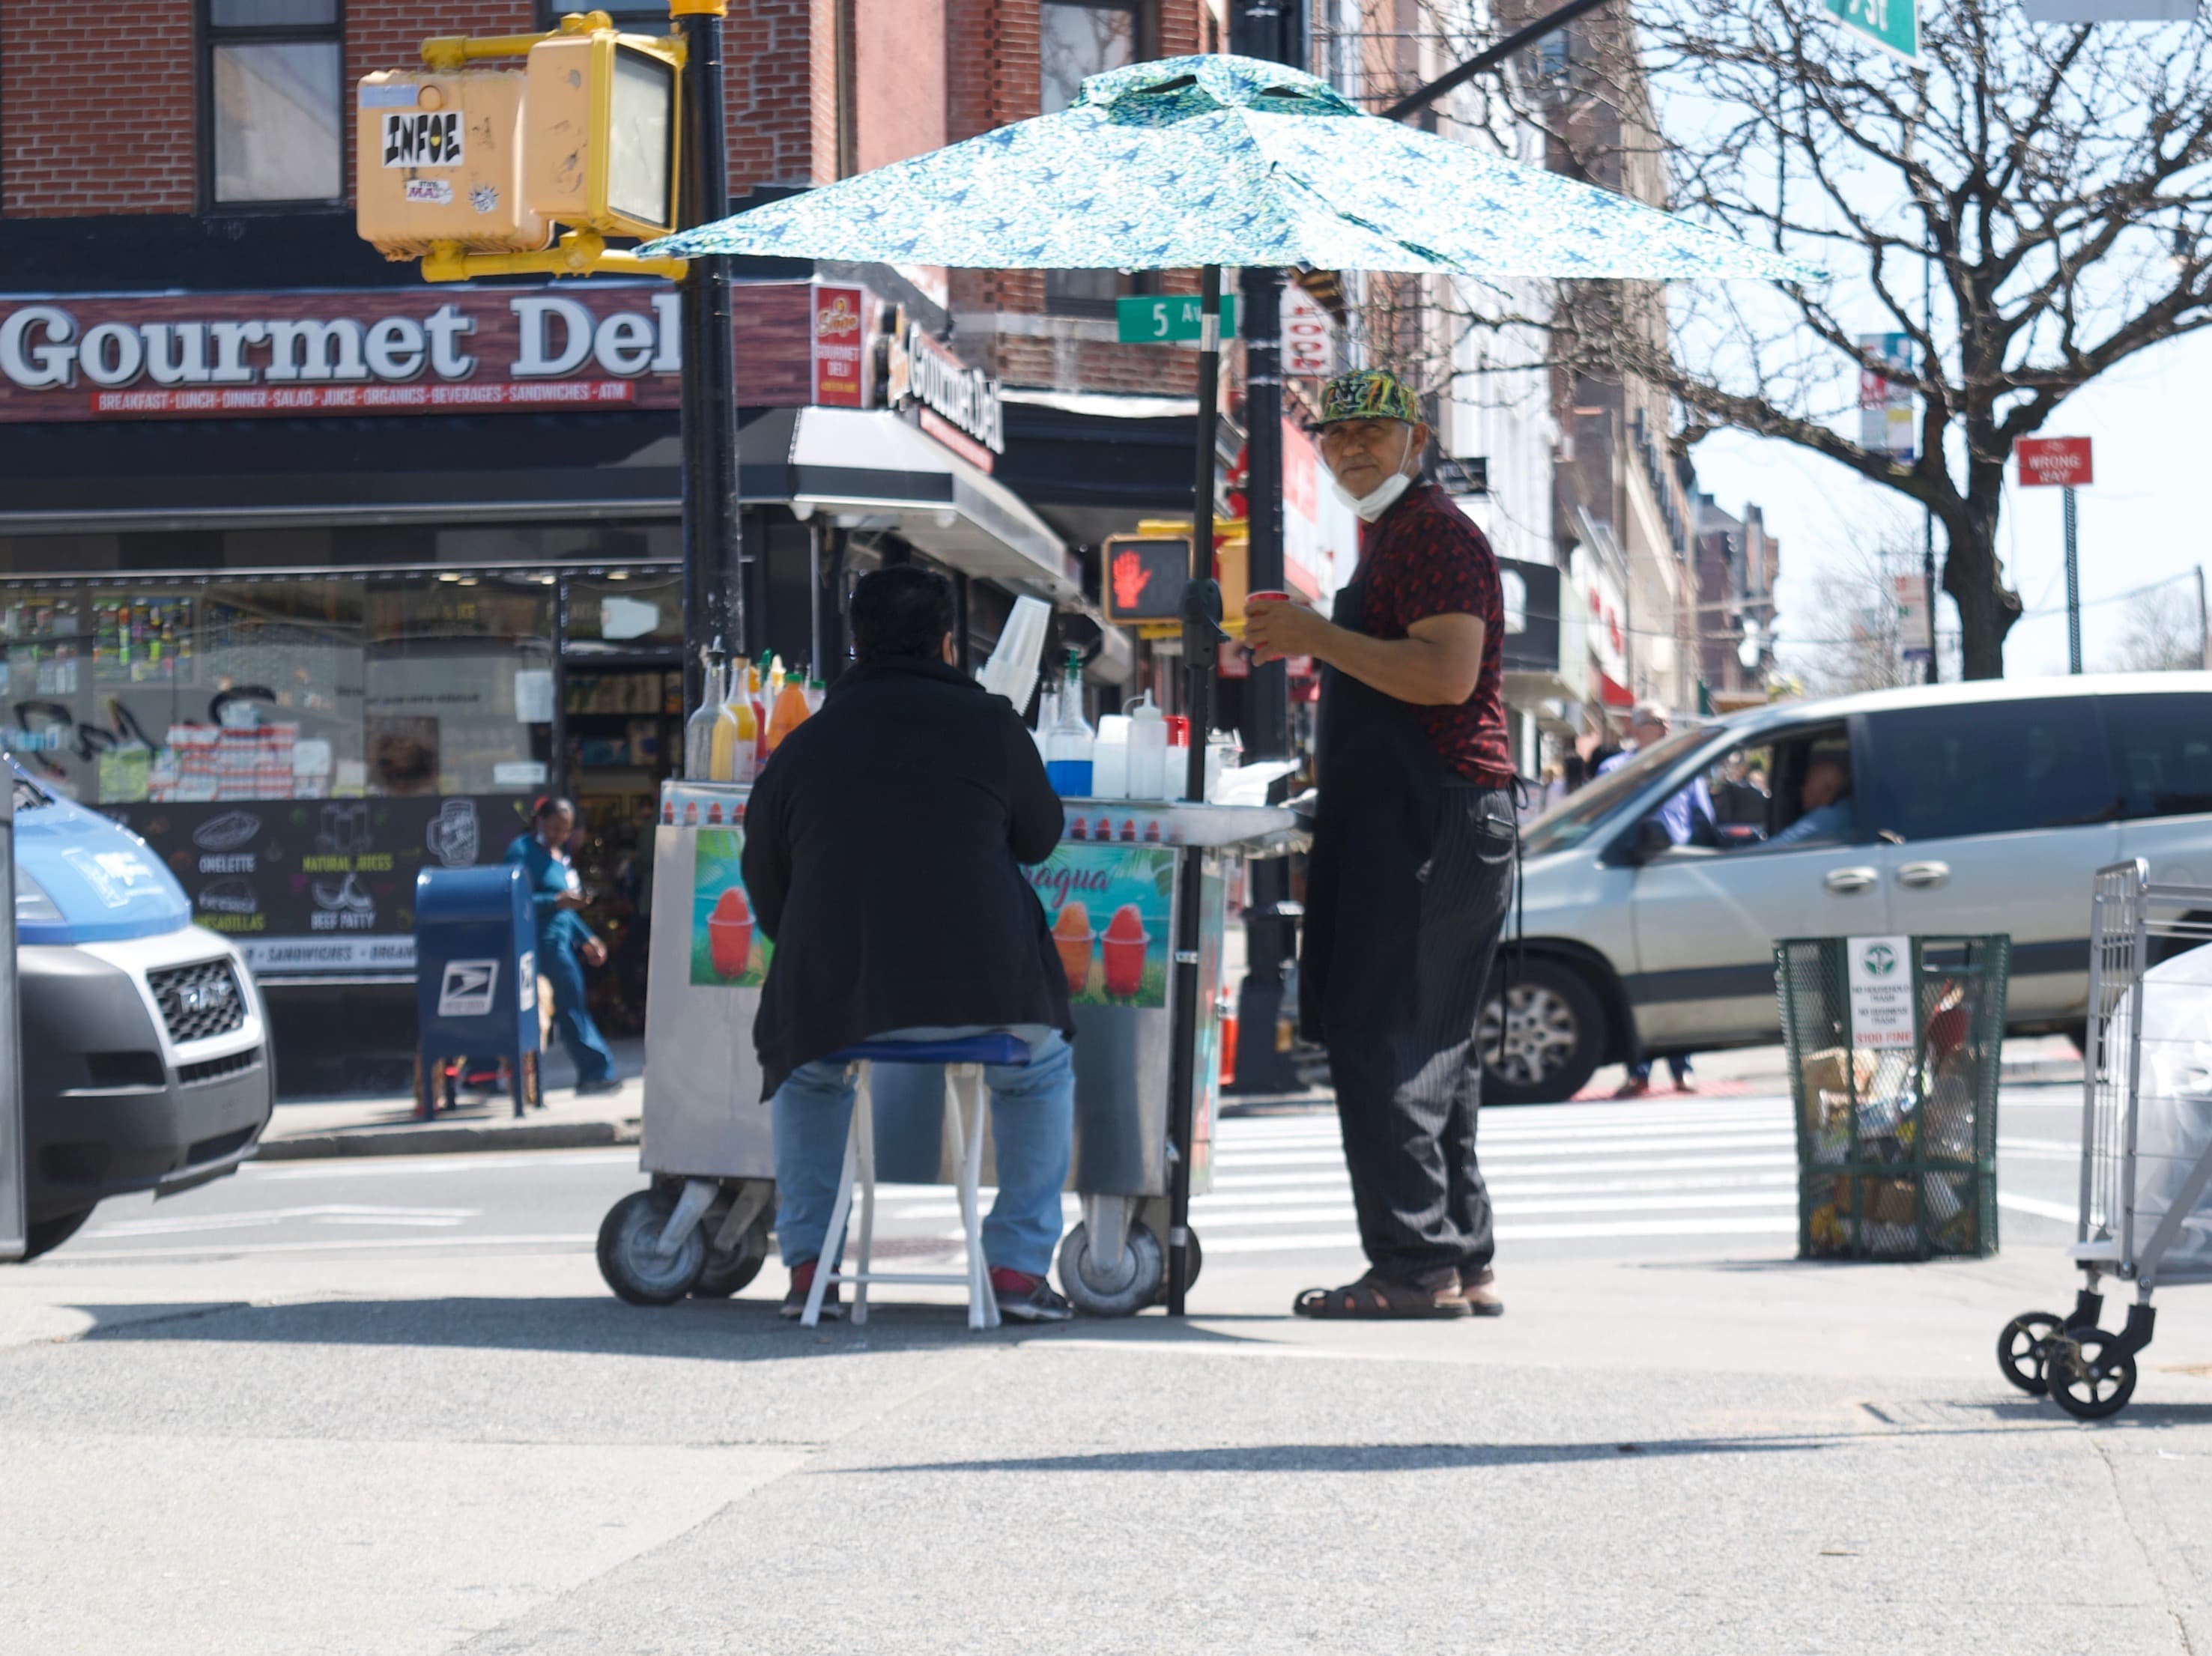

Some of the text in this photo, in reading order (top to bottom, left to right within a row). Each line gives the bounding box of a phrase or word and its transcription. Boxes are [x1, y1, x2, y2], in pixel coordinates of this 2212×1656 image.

[384, 113, 461, 166] INFOE
[1153, 303, 1169, 337] 5
[0, 293, 681, 390] Gourmet Del
[99, 382, 625, 411] BREAKFAST LUNCH DINNER SALAD JUICE ORGANICS BEVERAGES SANDWICHES ATM
[2028, 454, 2081, 469] WRONG
[2039, 469, 2072, 483] WAY
[199, 854, 257, 873] OMELETTE
[1022, 865, 1109, 909] agua
[193, 913, 265, 931] ESADILLAS
[1886, 1030, 1912, 1043] FINE
